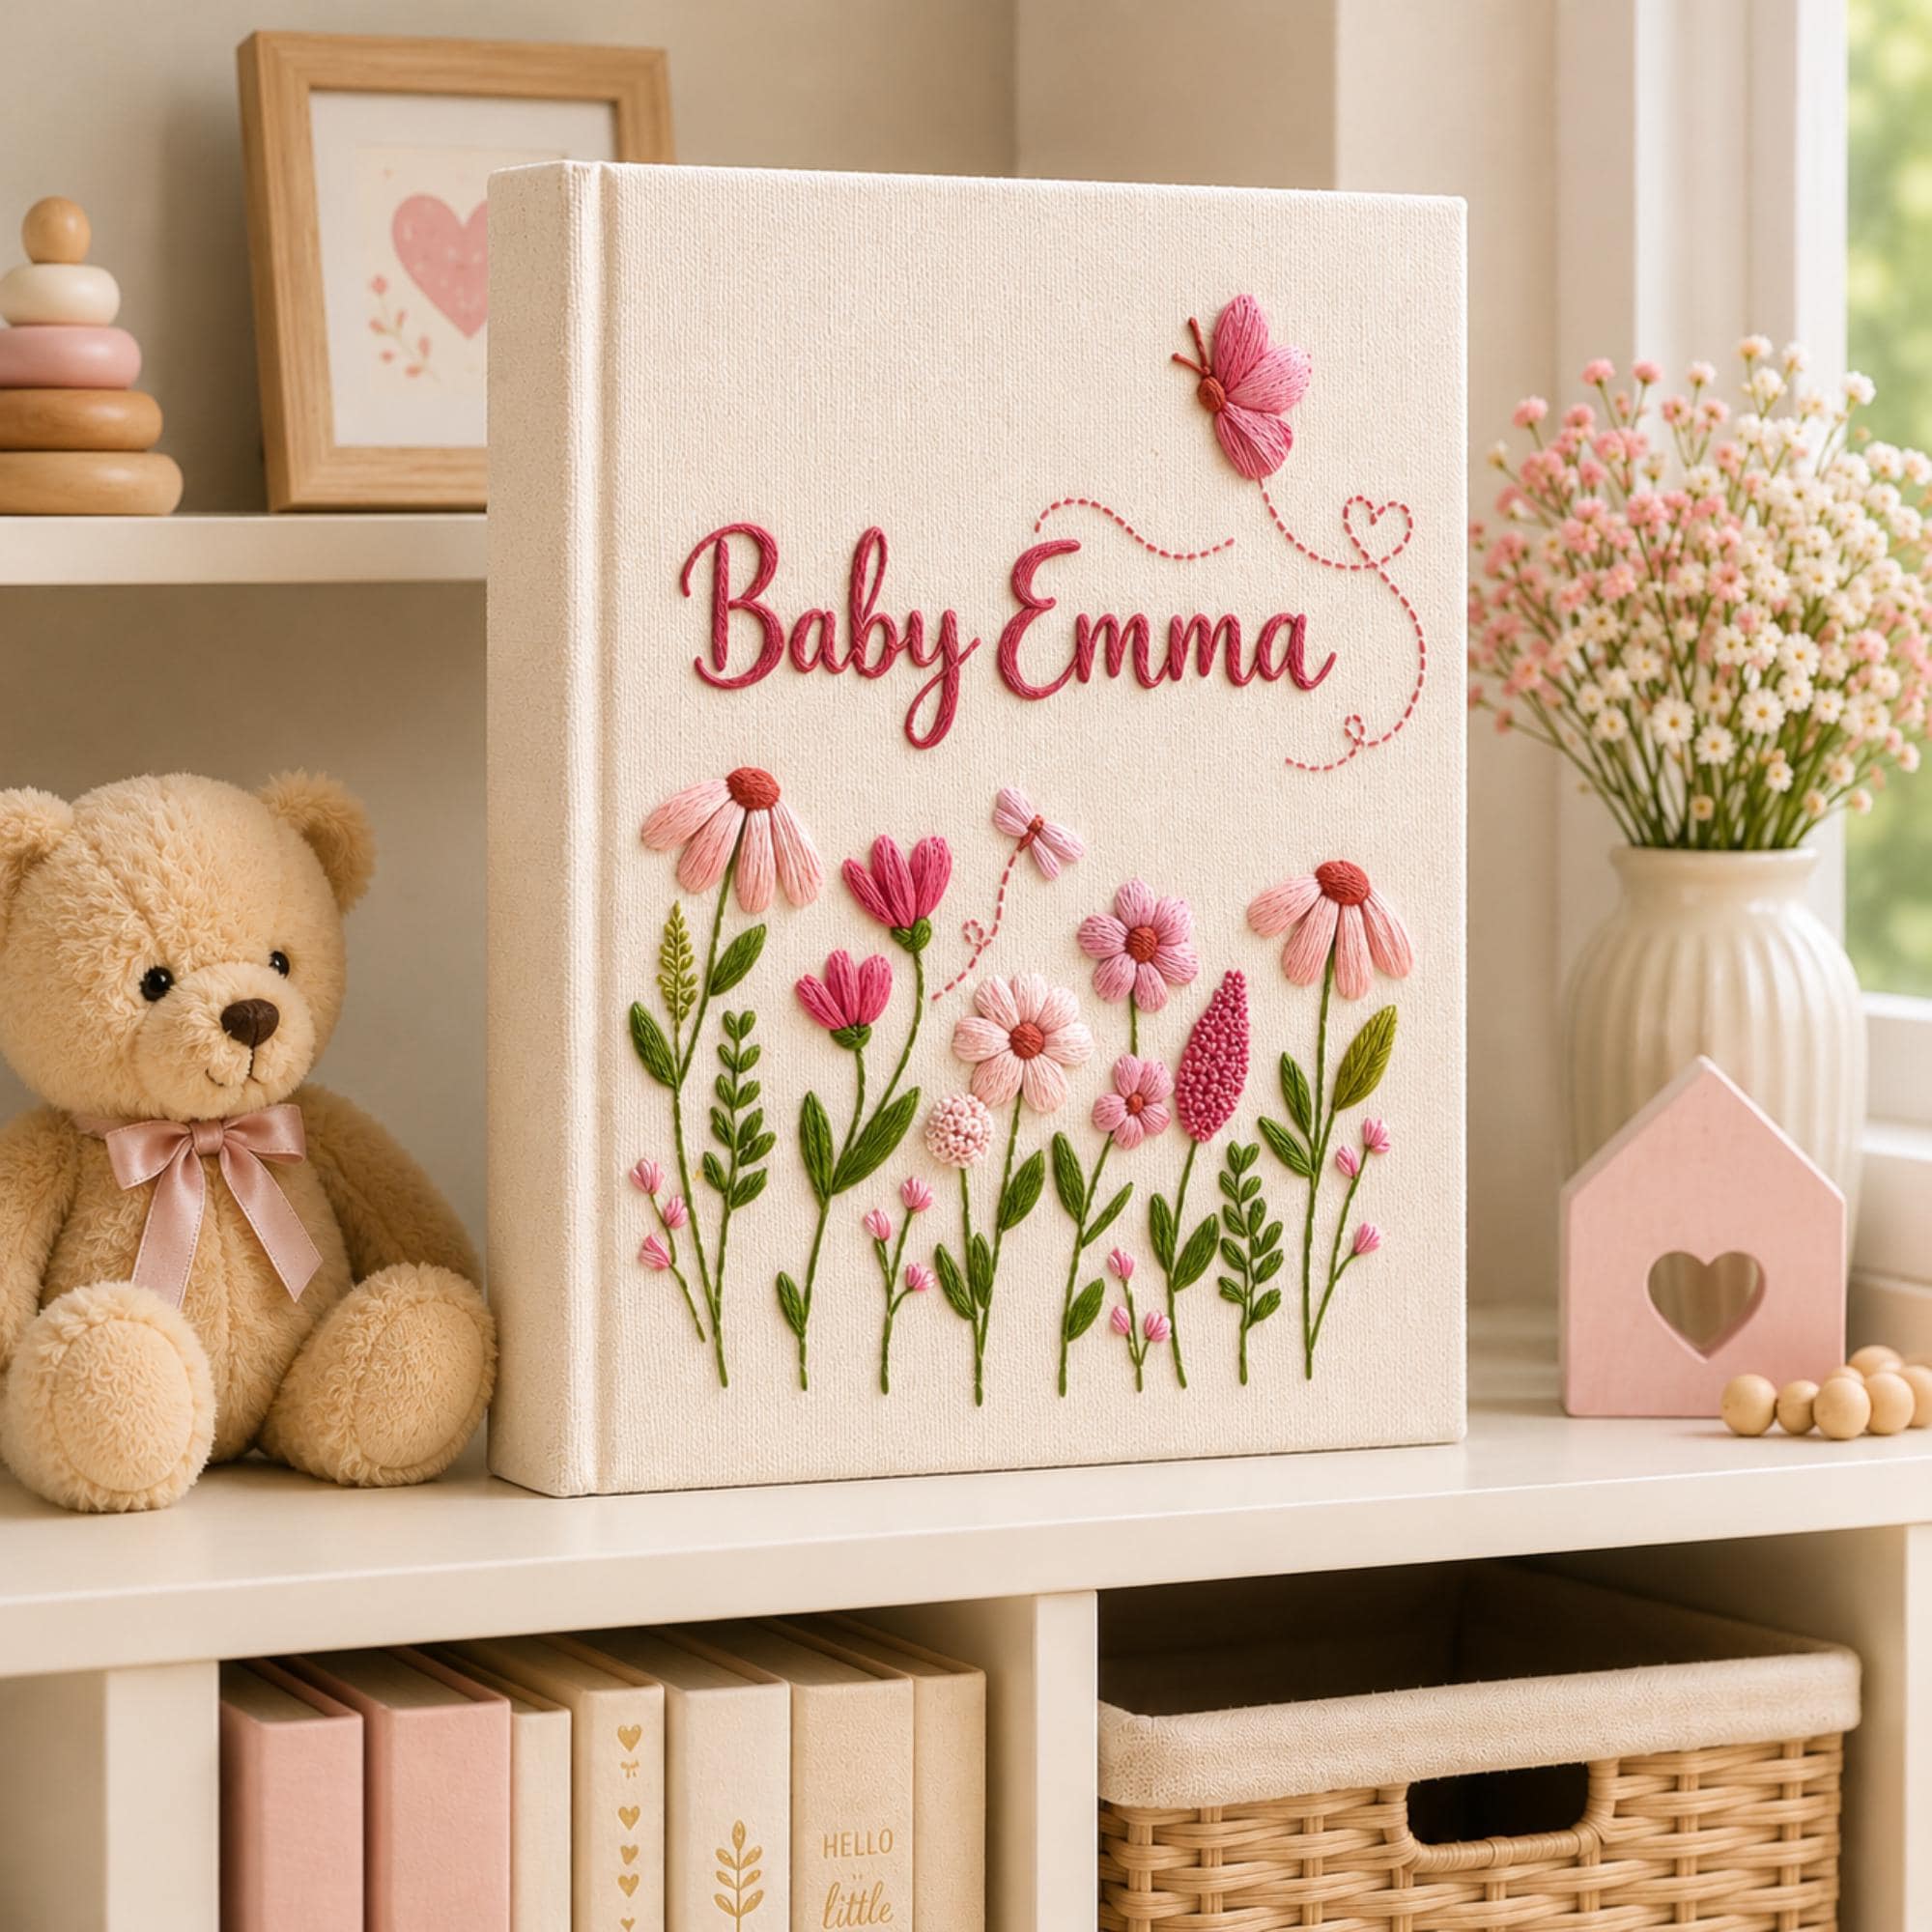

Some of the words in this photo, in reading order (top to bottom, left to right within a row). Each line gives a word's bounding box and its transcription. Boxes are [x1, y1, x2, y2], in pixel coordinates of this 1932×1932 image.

[679, 523, 980, 750] Baby
[996, 539, 1337, 701] Emma
[823, 1828, 894, 1860] HELLO
[822, 1880, 894, 1930] little
